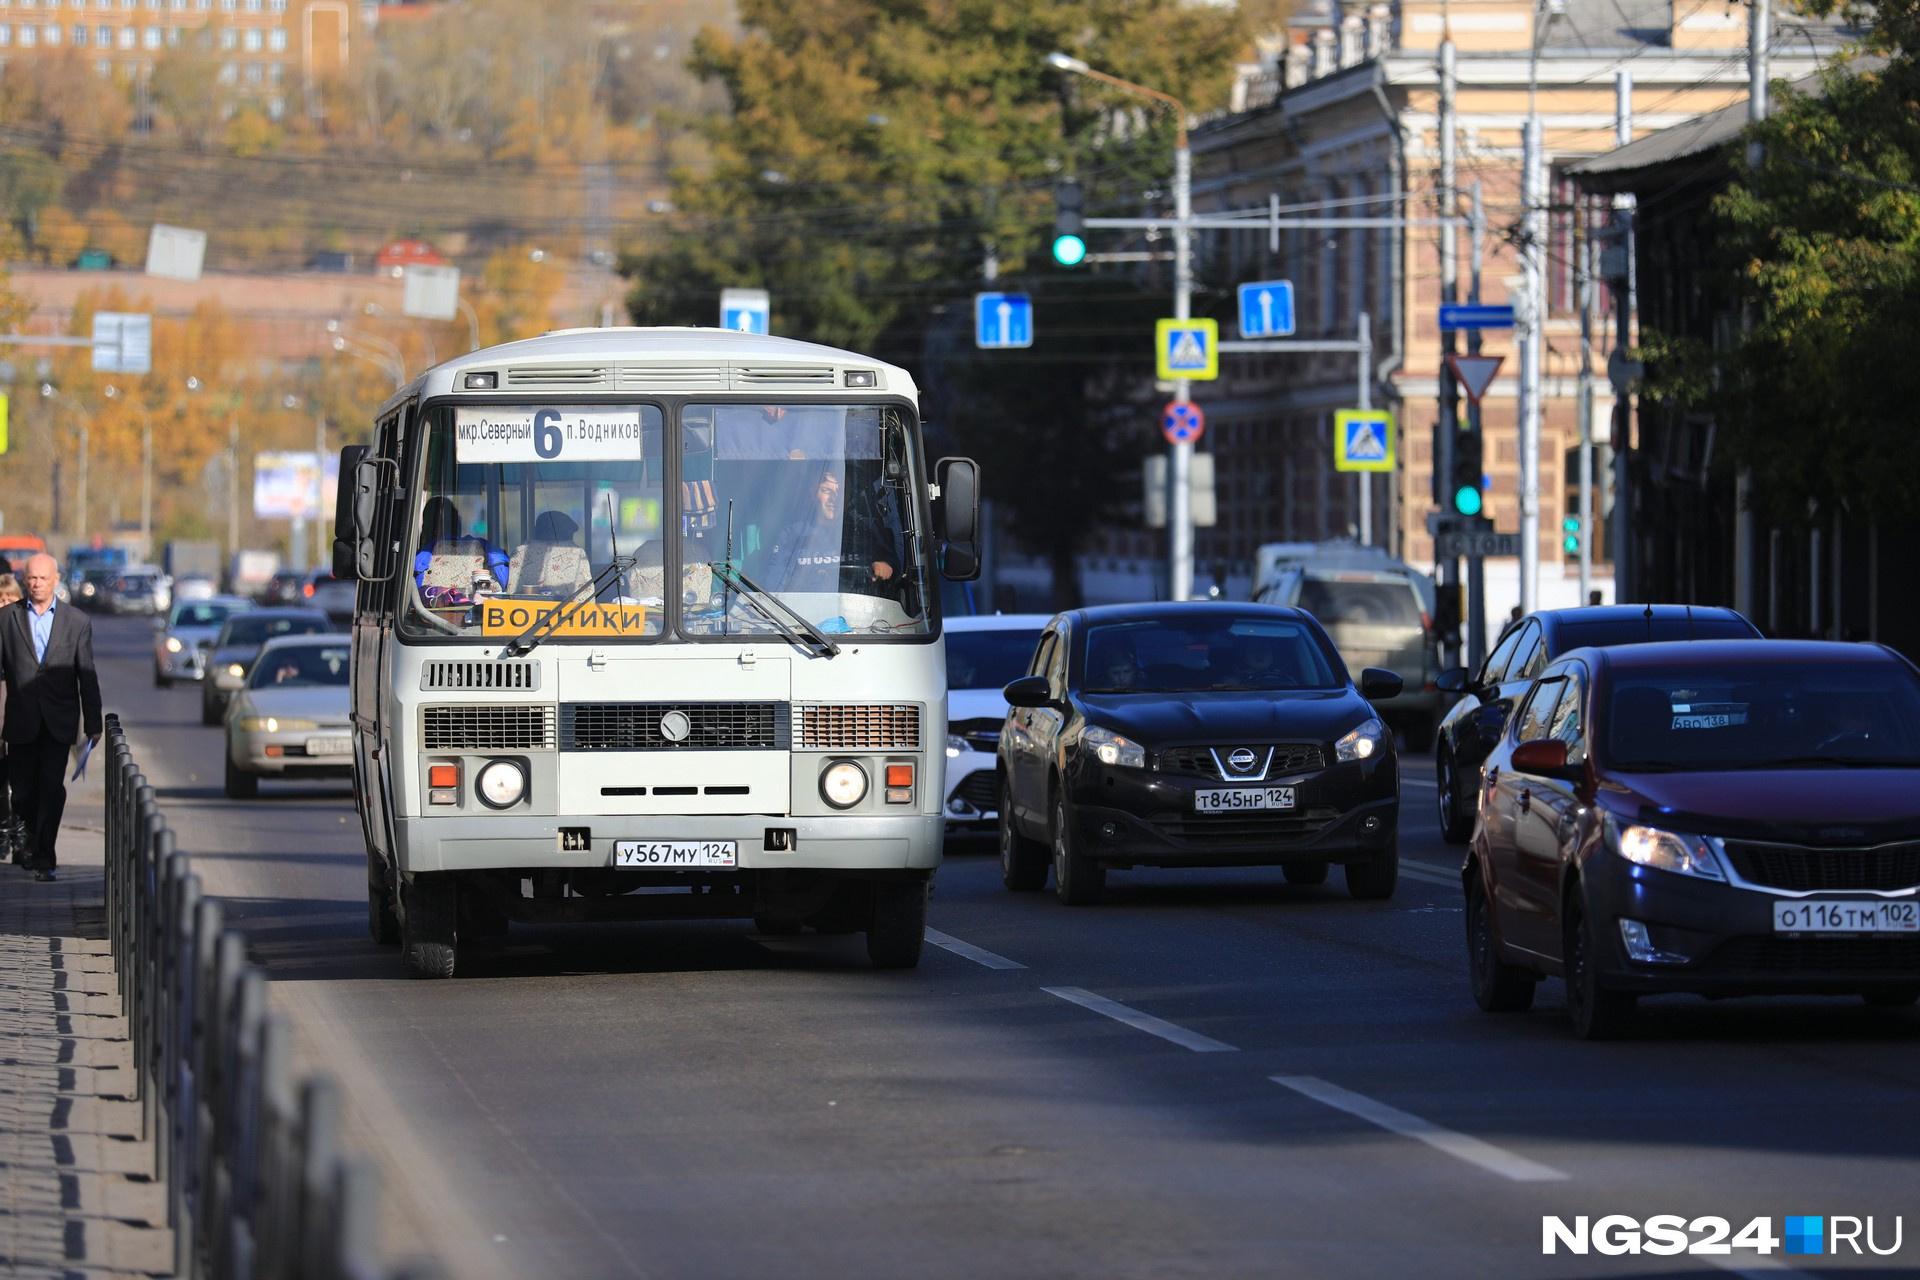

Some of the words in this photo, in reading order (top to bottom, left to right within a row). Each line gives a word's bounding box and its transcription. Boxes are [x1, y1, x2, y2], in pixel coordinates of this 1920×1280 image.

[533, 408, 563, 460] 6
[487, 607, 640, 629] ВОДНИКИ
[1200, 791, 1263, 809] Т845НР
[1267, 790, 1291, 802] 124
[624, 844, 698, 863] У567МУ
[702, 843, 729, 858] 124
[1879, 904, 1913, 922] 102
